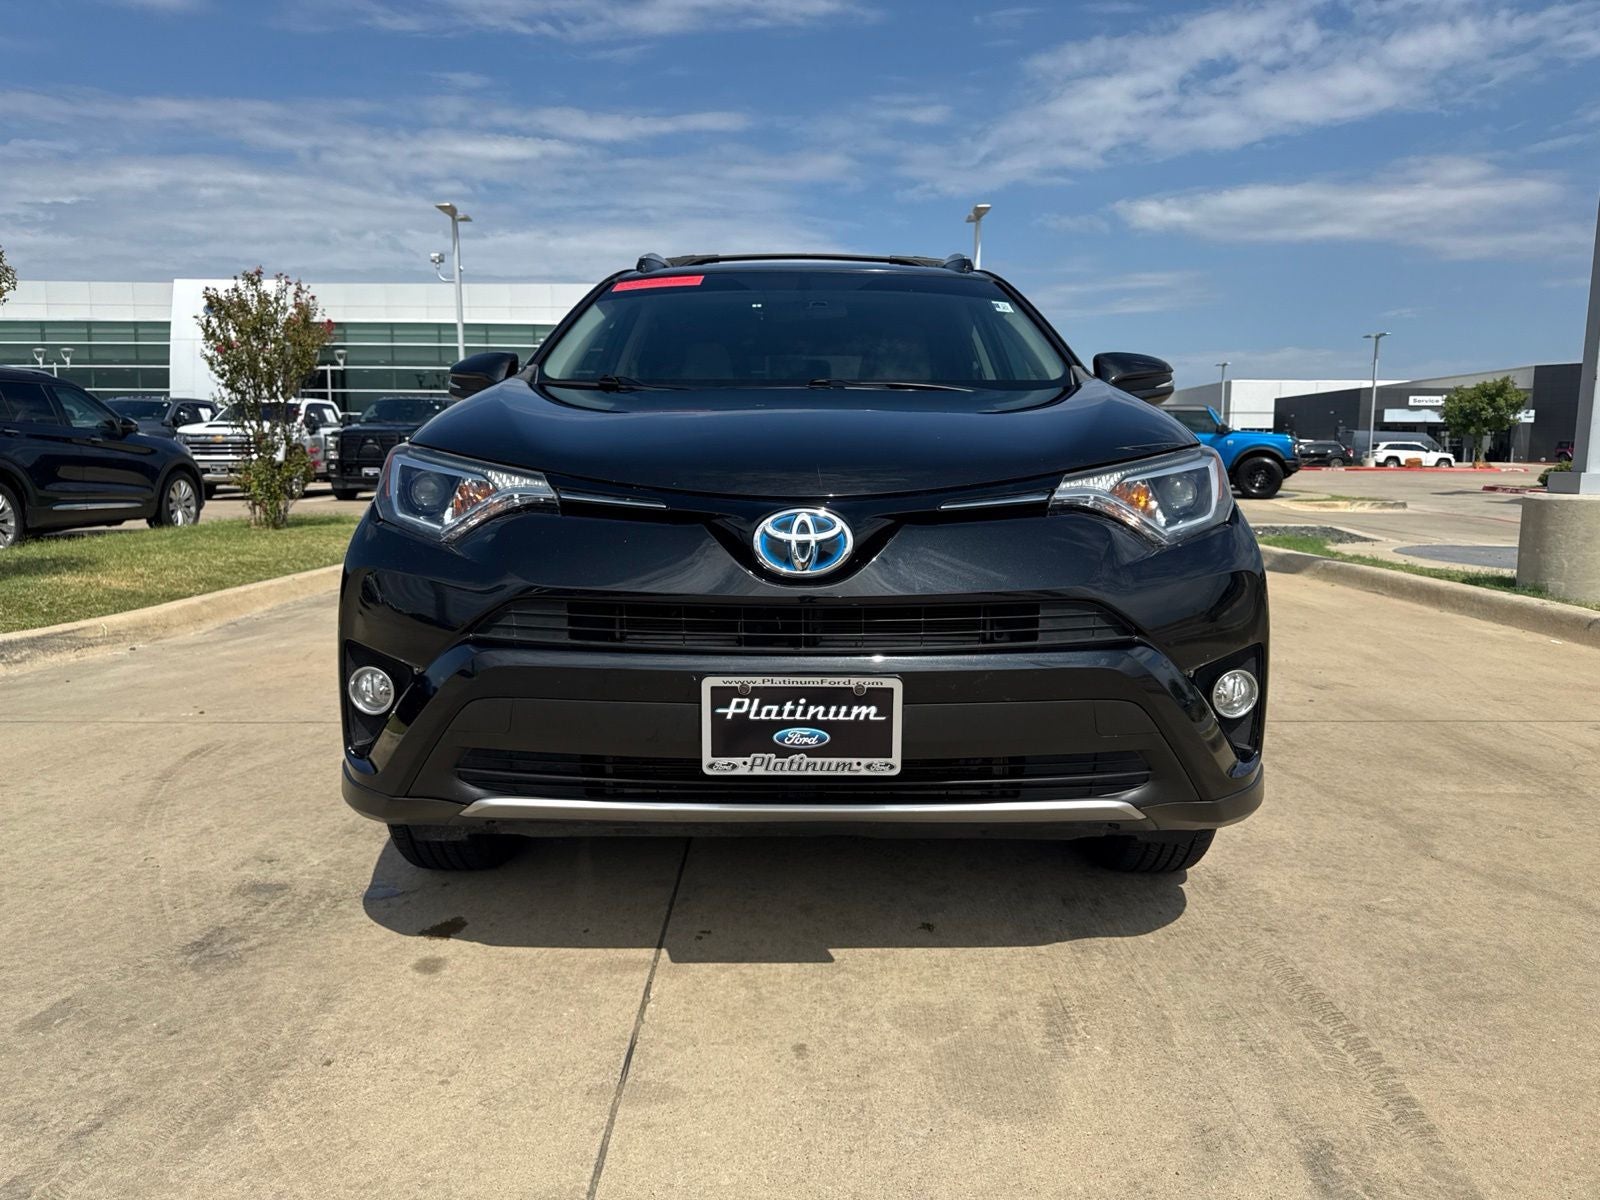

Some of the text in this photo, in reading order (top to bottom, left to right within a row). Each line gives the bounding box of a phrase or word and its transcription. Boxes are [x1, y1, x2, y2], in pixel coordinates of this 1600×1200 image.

[722, 678, 884, 687] www.PlatinumFord.com
[715, 698, 887, 721] Platinum
[784, 729, 819, 745] Ford
[748, 756, 862, 773] Platinum
